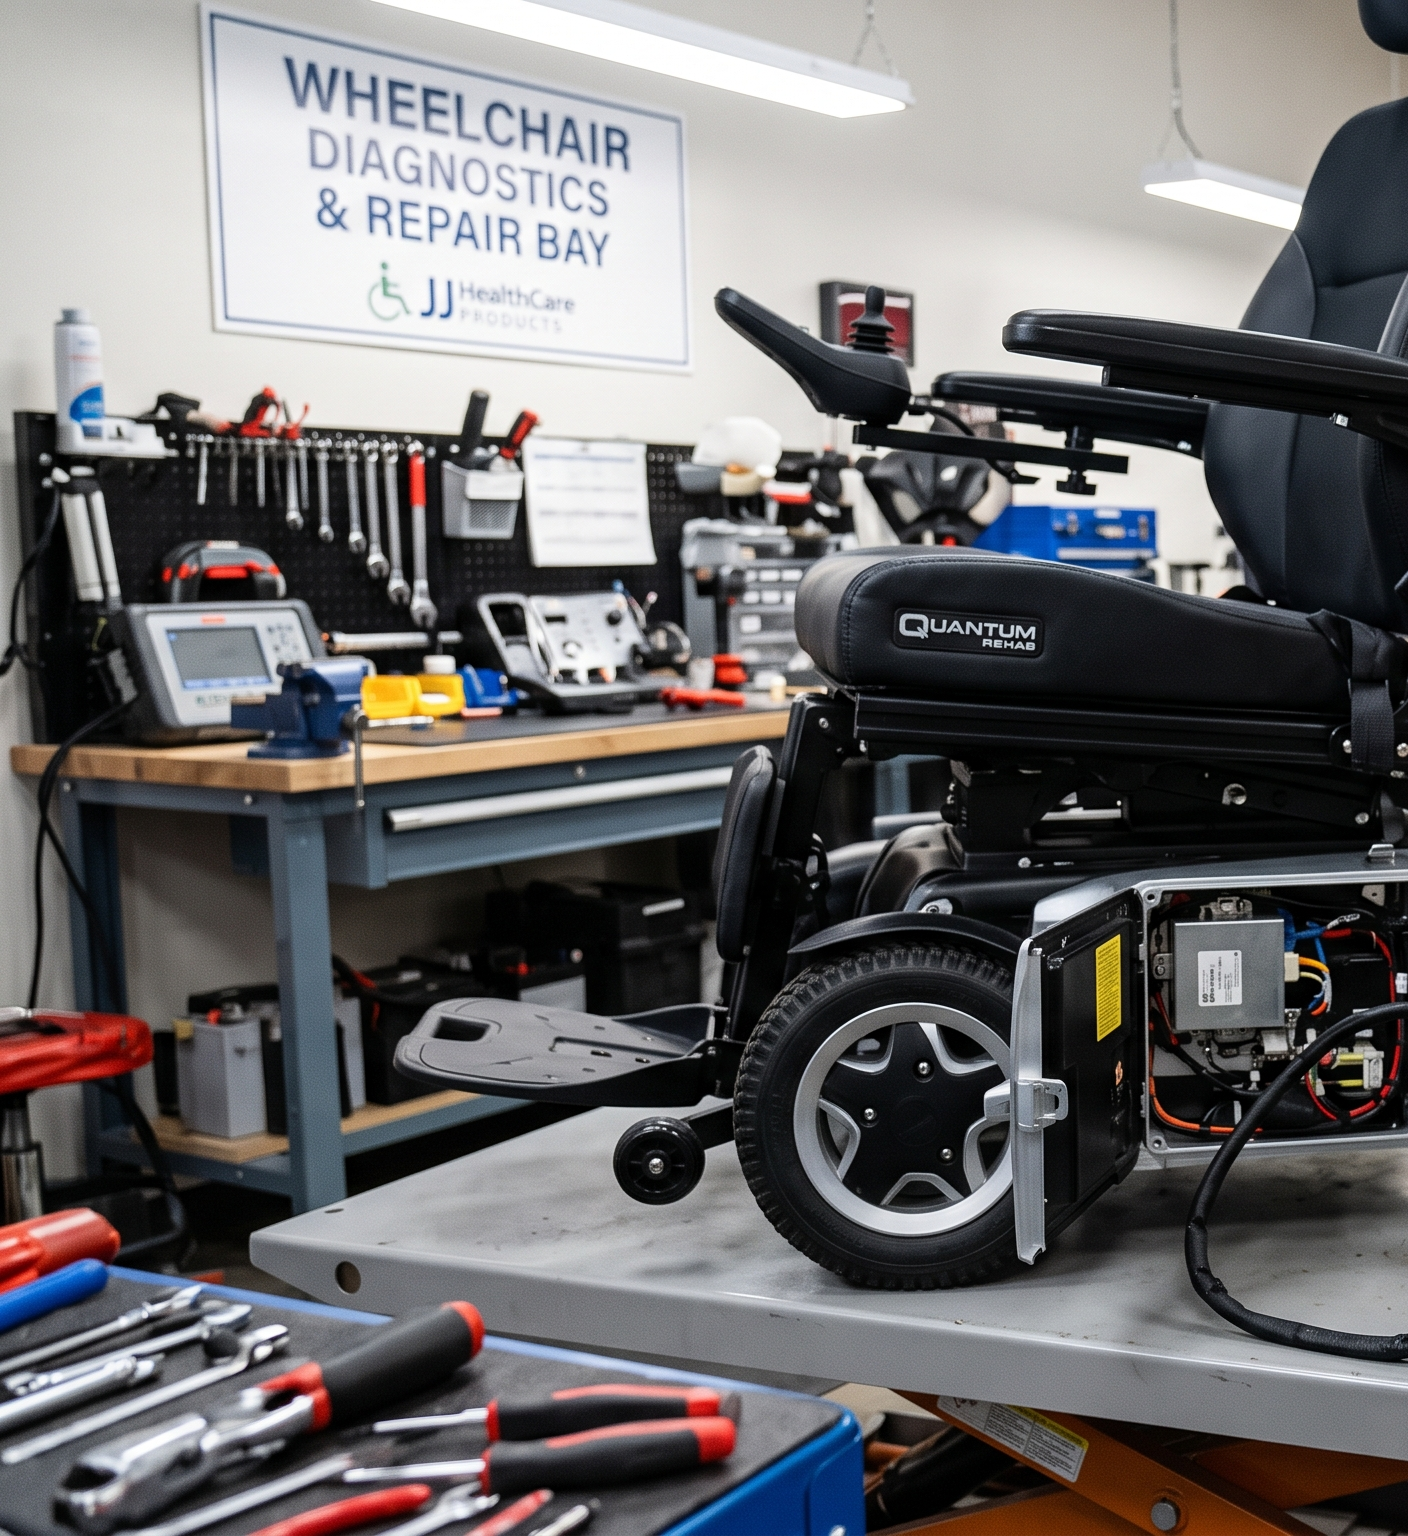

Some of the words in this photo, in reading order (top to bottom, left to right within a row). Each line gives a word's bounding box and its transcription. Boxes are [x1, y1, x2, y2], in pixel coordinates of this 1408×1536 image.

[284, 55, 631, 172] WHEELCHAIR
[308, 126, 609, 217] DIAGNOSTICS
[316, 187, 349, 231] &
[367, 195, 521, 256] REPAIR
[537, 222, 609, 267] BAY
[420, 278, 453, 319] JJ
[459, 281, 576, 313] HealthCare
[460, 307, 564, 334] PRODUCTS
[899, 613, 1036, 640] QUANTUM
[982, 638, 1035, 651] REHAB
